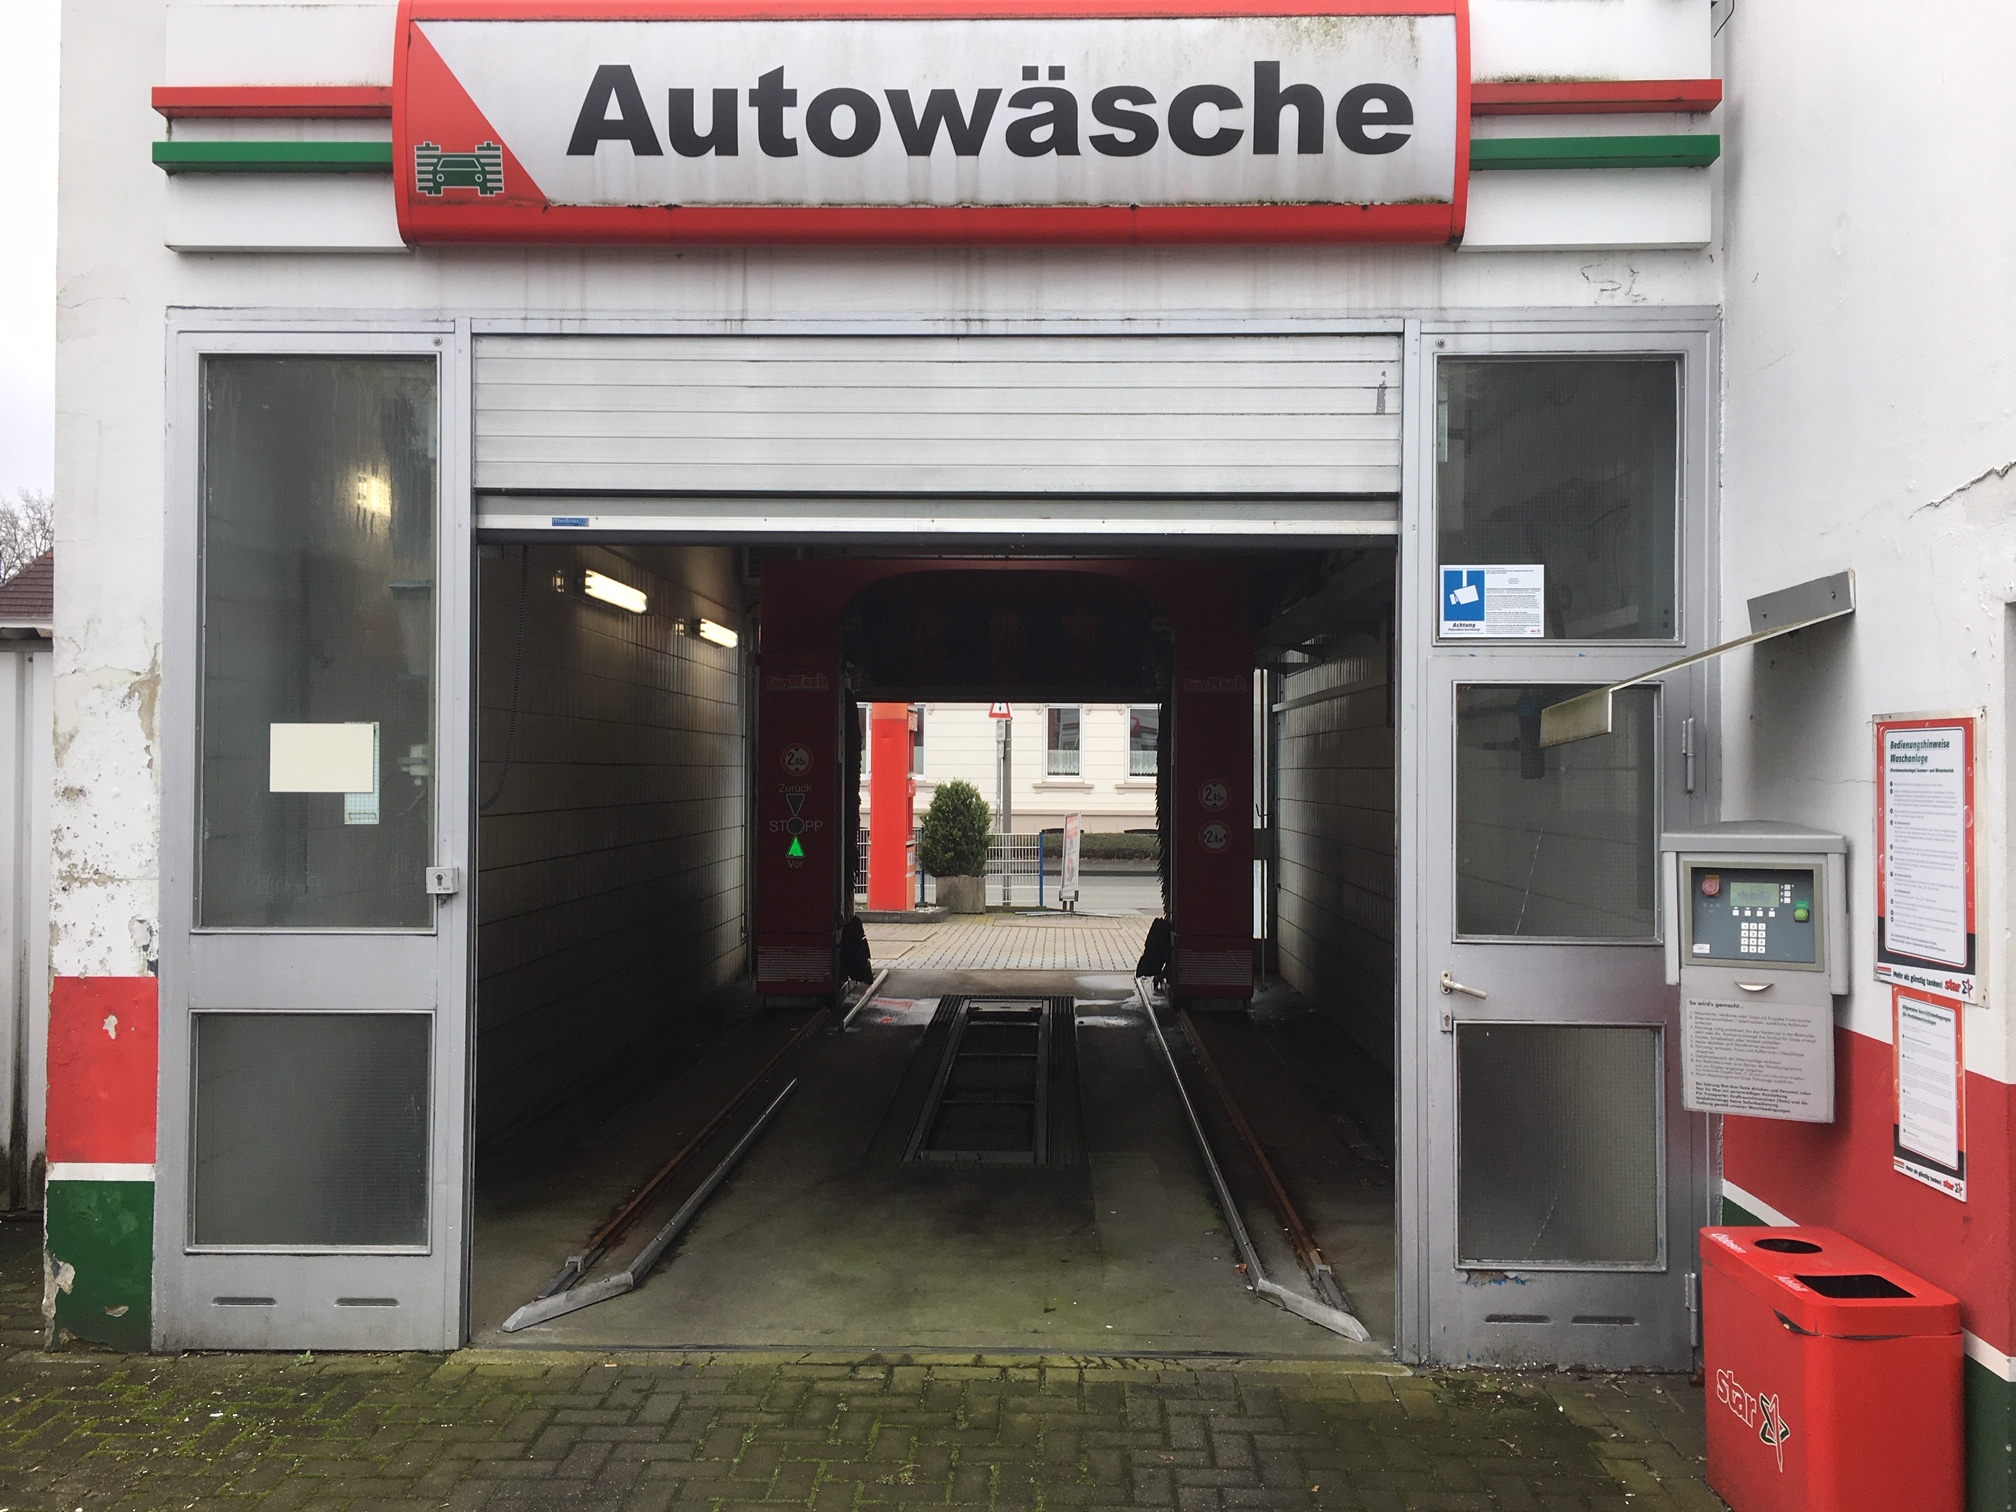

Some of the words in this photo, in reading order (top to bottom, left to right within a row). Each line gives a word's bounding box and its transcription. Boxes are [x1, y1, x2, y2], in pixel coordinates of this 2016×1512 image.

[566, 60, 1414, 157] Autowäsche
[1890, 738, 1950, 751] Bedienungshinweise
[1890, 753, 1928, 765] Waschanlage
[779, 784, 812, 793] Zurück
[769, 817, 824, 834] STOPP
[788, 860, 804, 868] Vor
[1945, 979, 1961, 992] star
[1717, 1369, 1757, 1428] star
